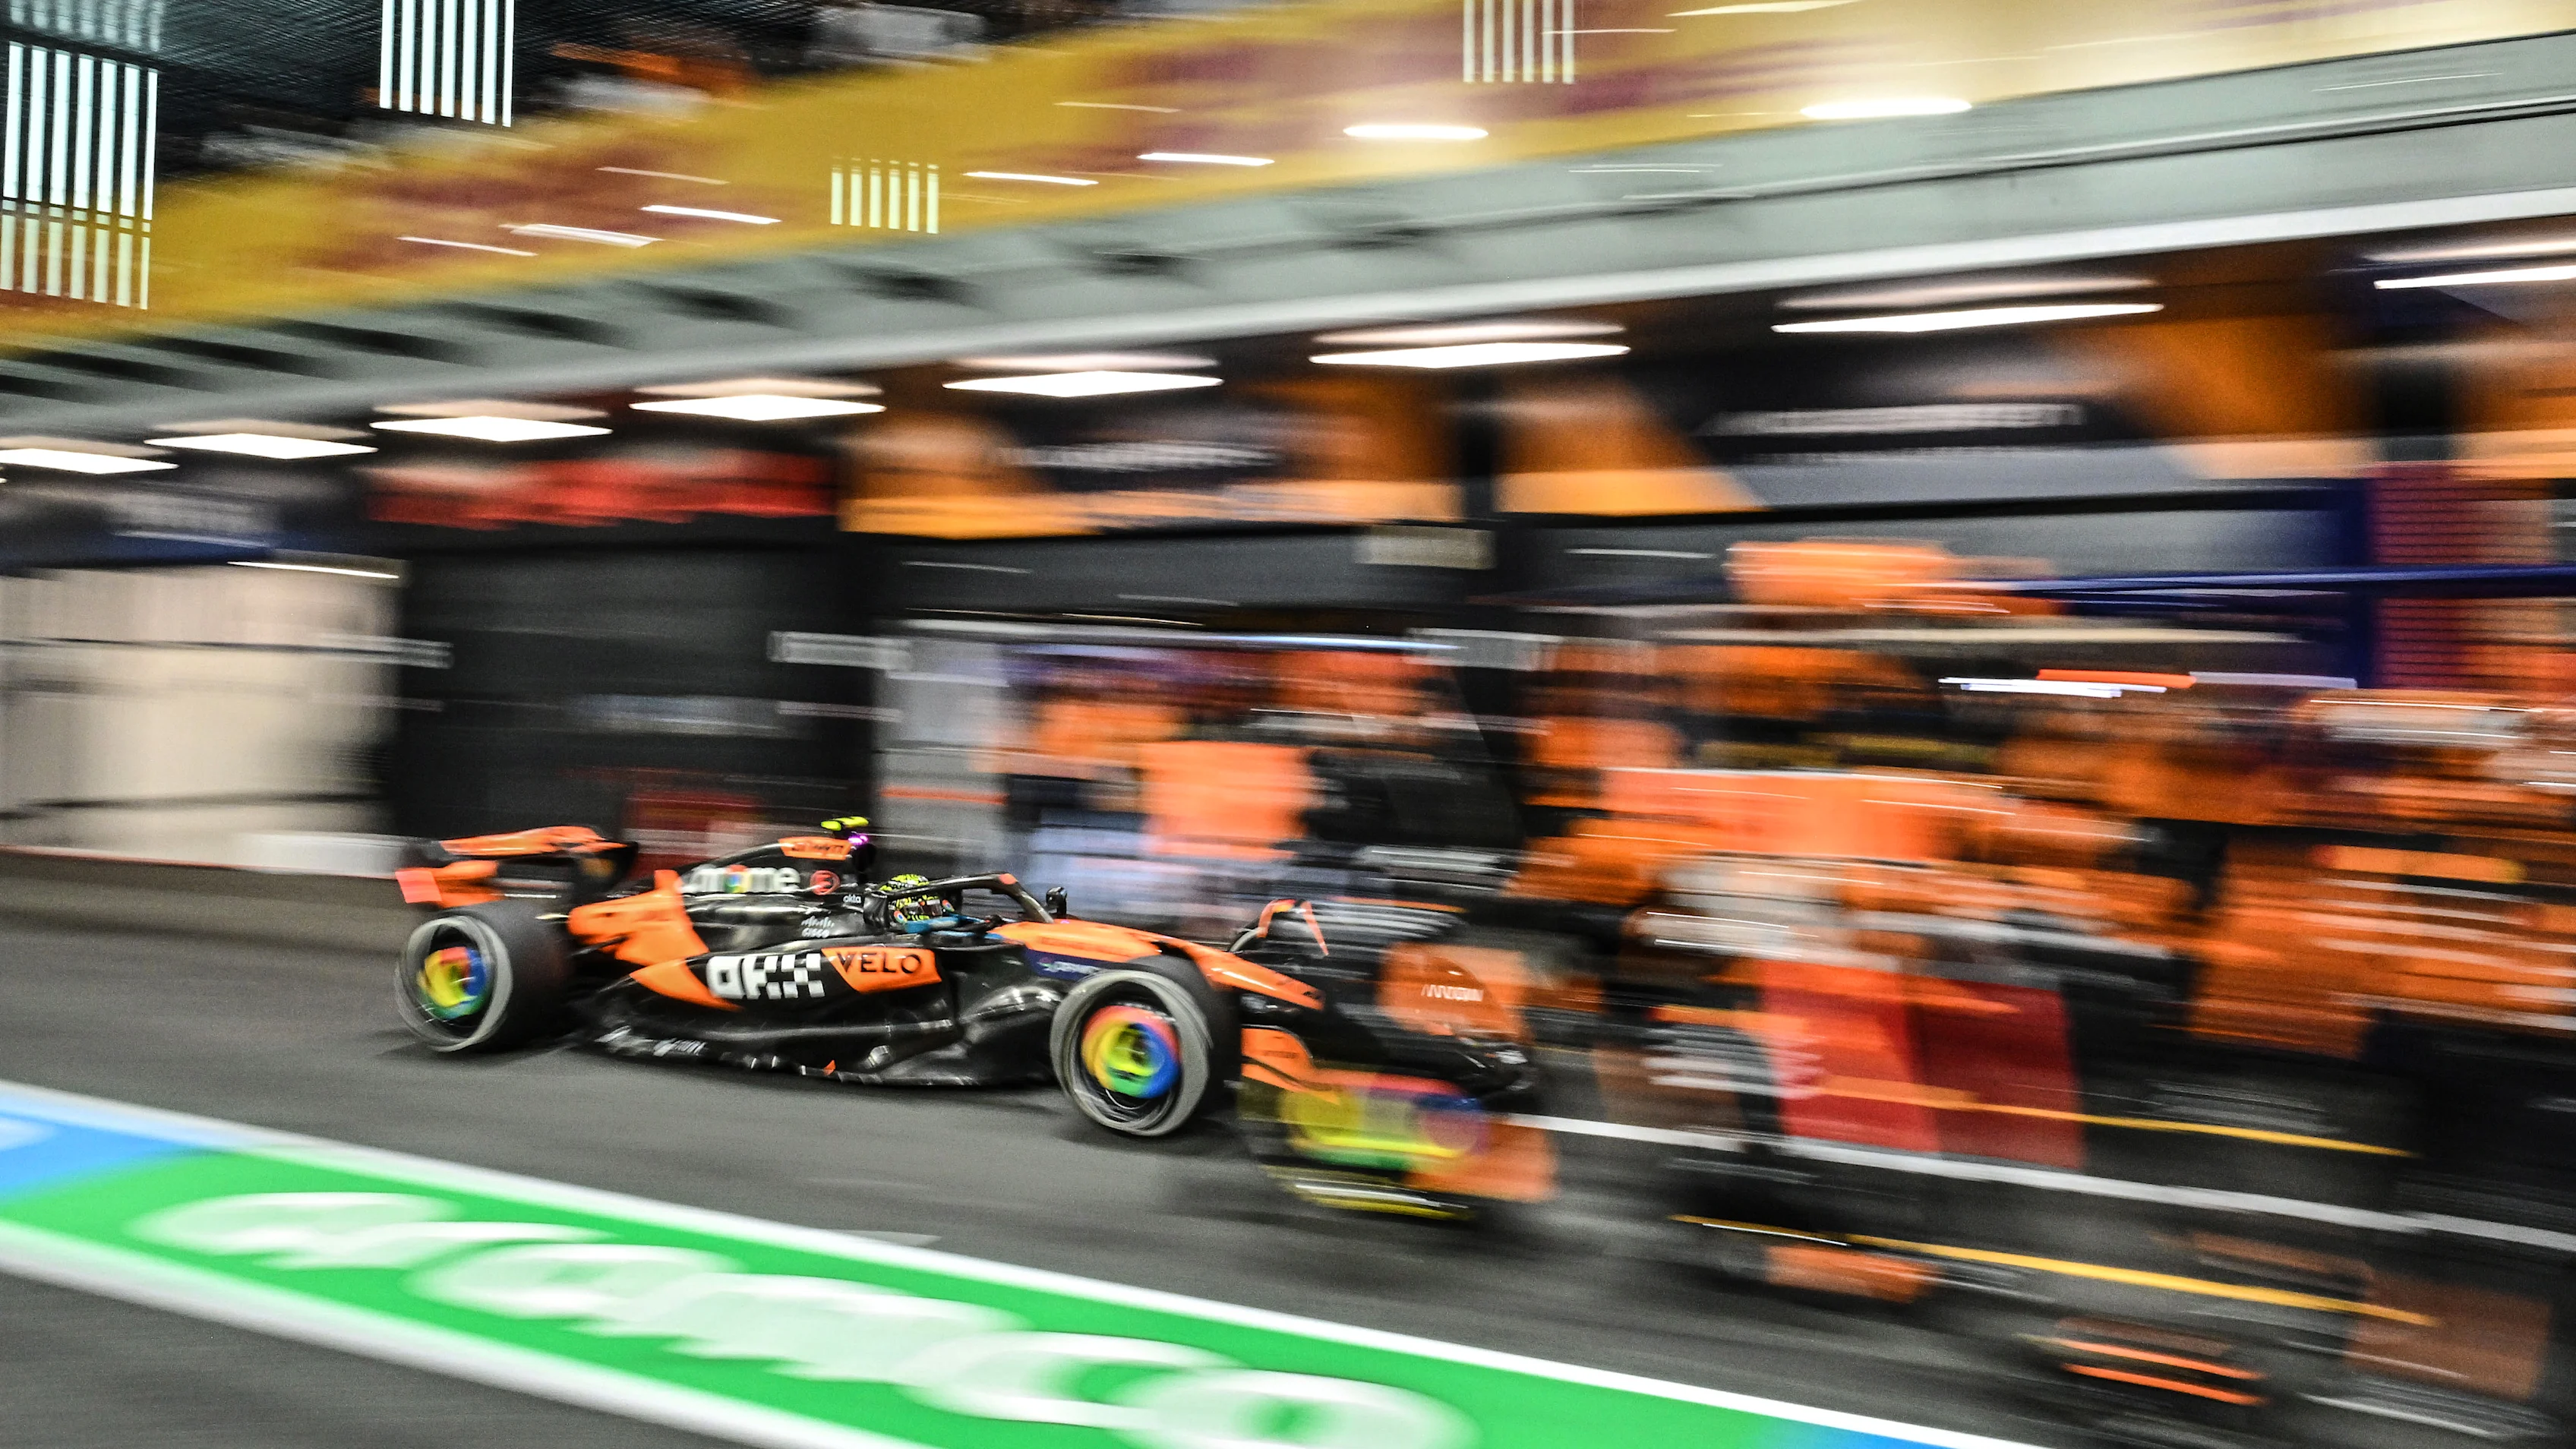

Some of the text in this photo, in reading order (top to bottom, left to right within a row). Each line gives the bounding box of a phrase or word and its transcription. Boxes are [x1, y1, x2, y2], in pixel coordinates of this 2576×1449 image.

[842, 893, 862, 904] okta
[837, 952, 921, 974] VELO
[706, 952, 825, 999] OKX
